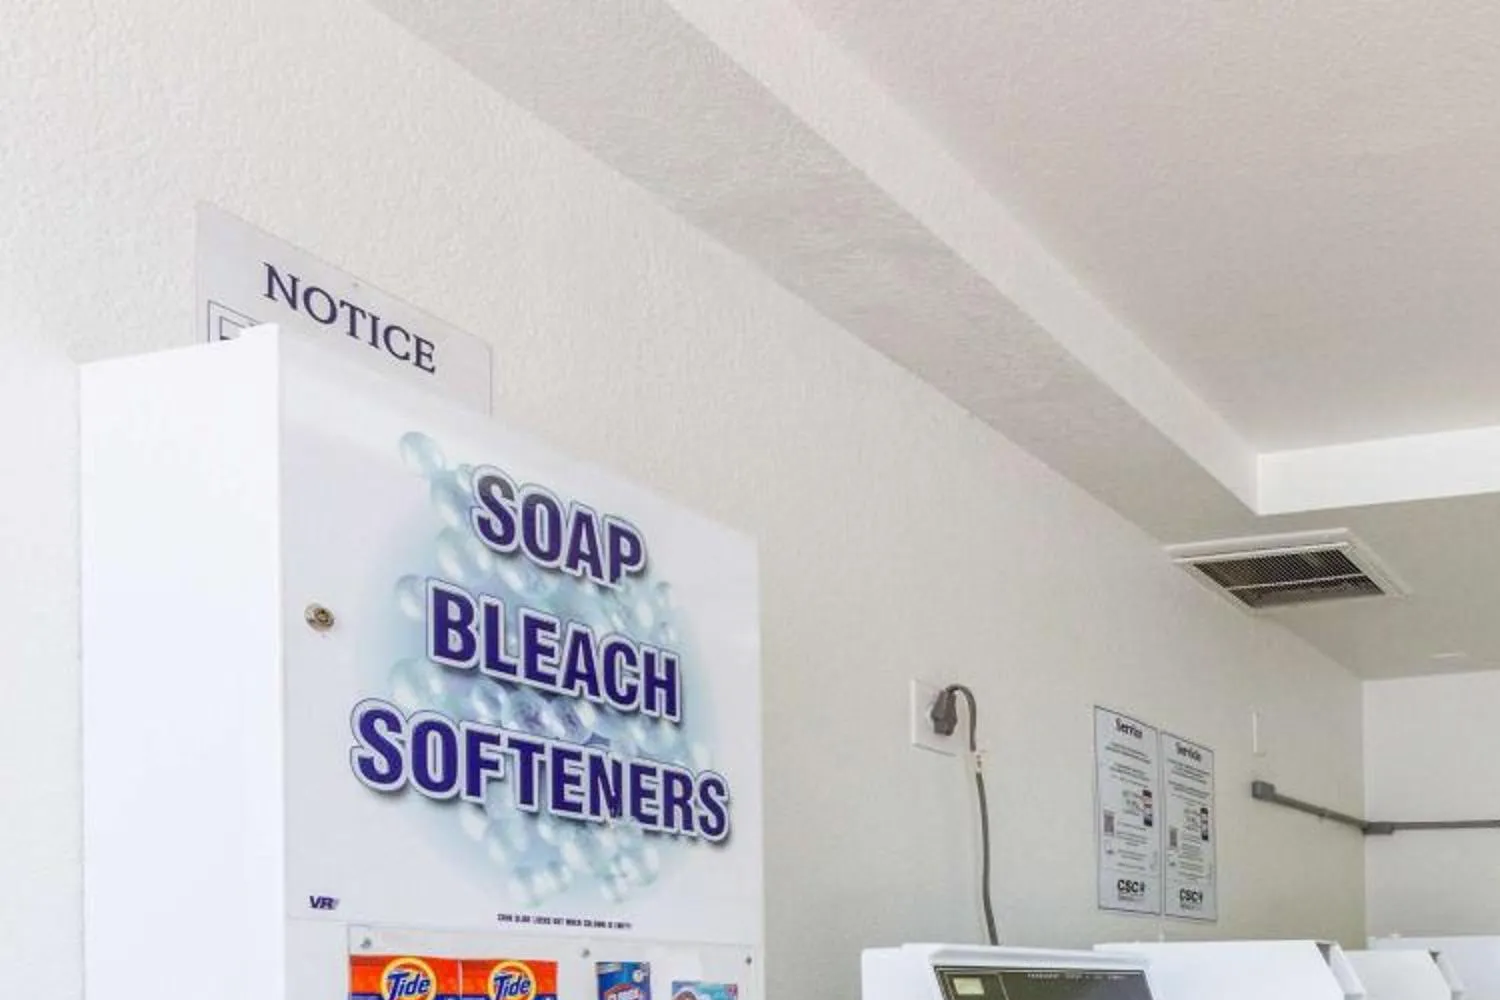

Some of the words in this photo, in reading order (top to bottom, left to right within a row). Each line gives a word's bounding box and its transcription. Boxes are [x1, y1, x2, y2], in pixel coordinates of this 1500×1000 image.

[263, 261, 437, 374] NOTICE
[474, 468, 646, 585] SOAP
[427, 580, 683, 721] BLEACH
[352, 701, 729, 841] SOFTENERS
